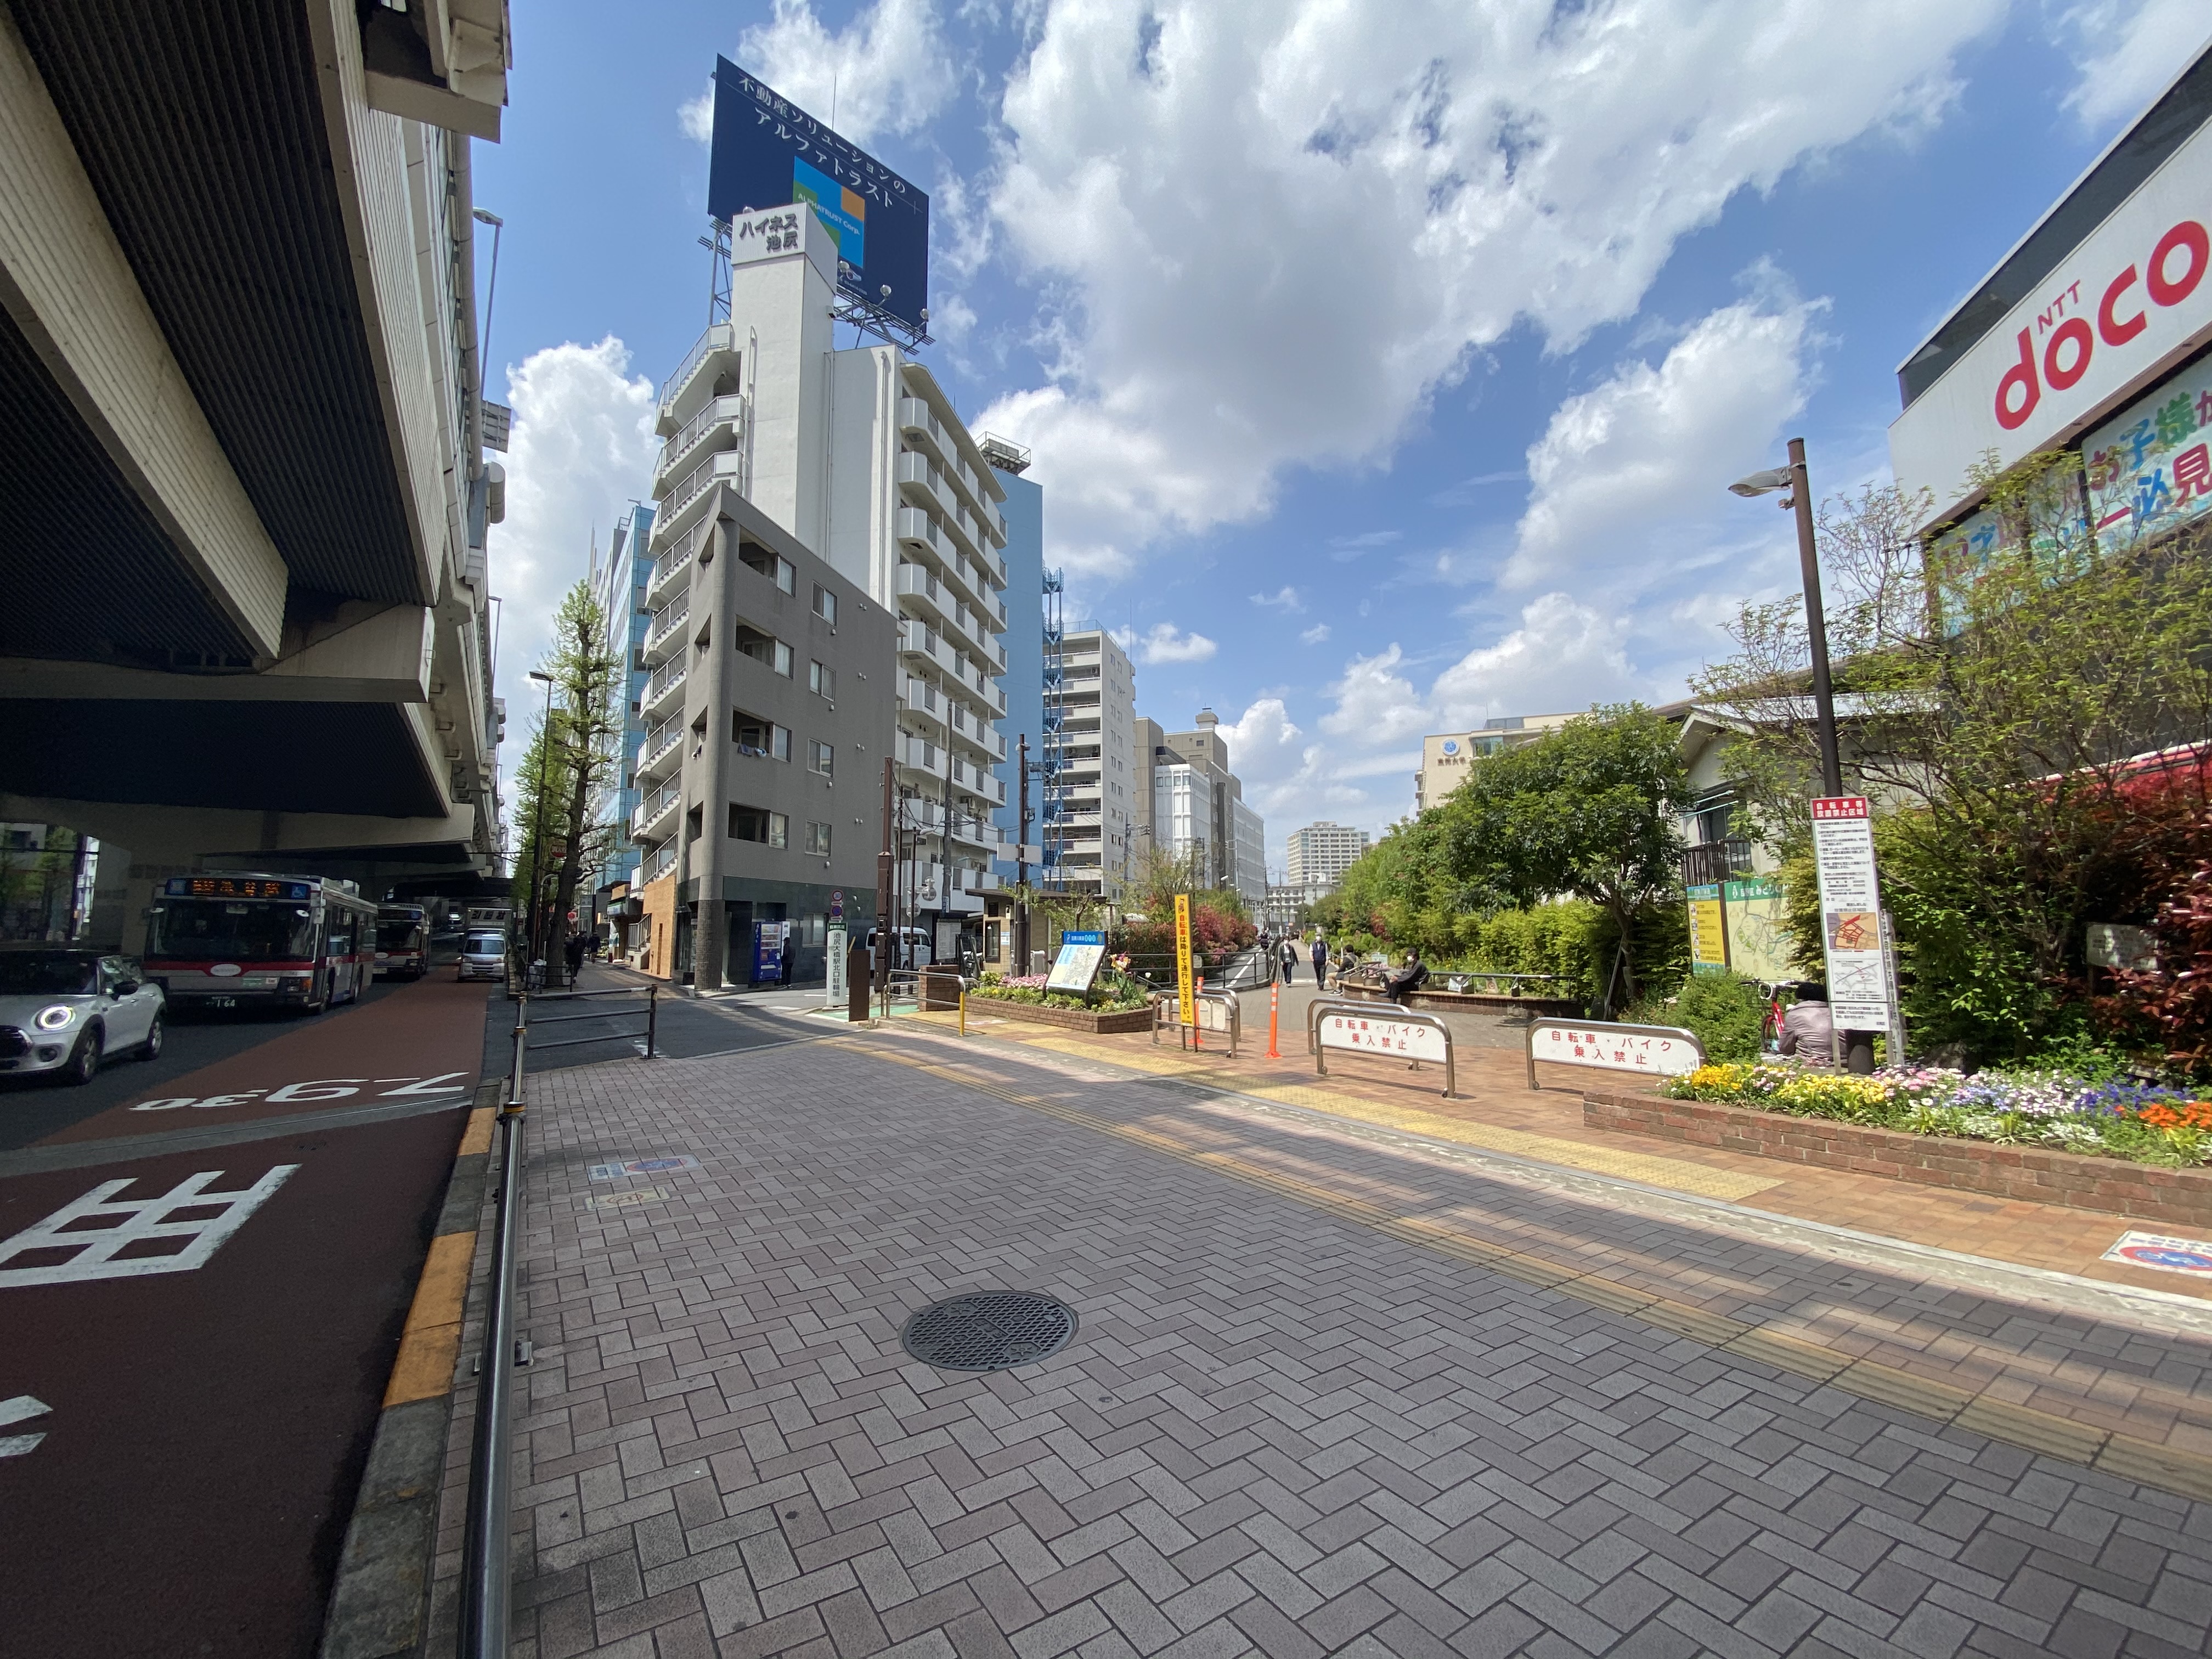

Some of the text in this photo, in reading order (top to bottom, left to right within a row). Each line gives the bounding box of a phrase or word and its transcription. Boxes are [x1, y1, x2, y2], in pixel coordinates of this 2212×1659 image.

[738, 72, 906, 195] 不動産ソリューションの
[755, 106, 893, 207] アルファトラスト
[739, 213, 798, 238] ハイネス
[766, 232, 799, 253] 池尻
[2038, 279, 2081, 335] NTT
[832, 932, 841, 997] 池尻大橋駅北口駐輪場
[1179, 915, 1190, 1019] 自転車は降りて通行して下さい。
[1352, 1033, 1407, 1050] 乗入禁止
[1574, 1044, 1647, 1065] 乗入禁止
